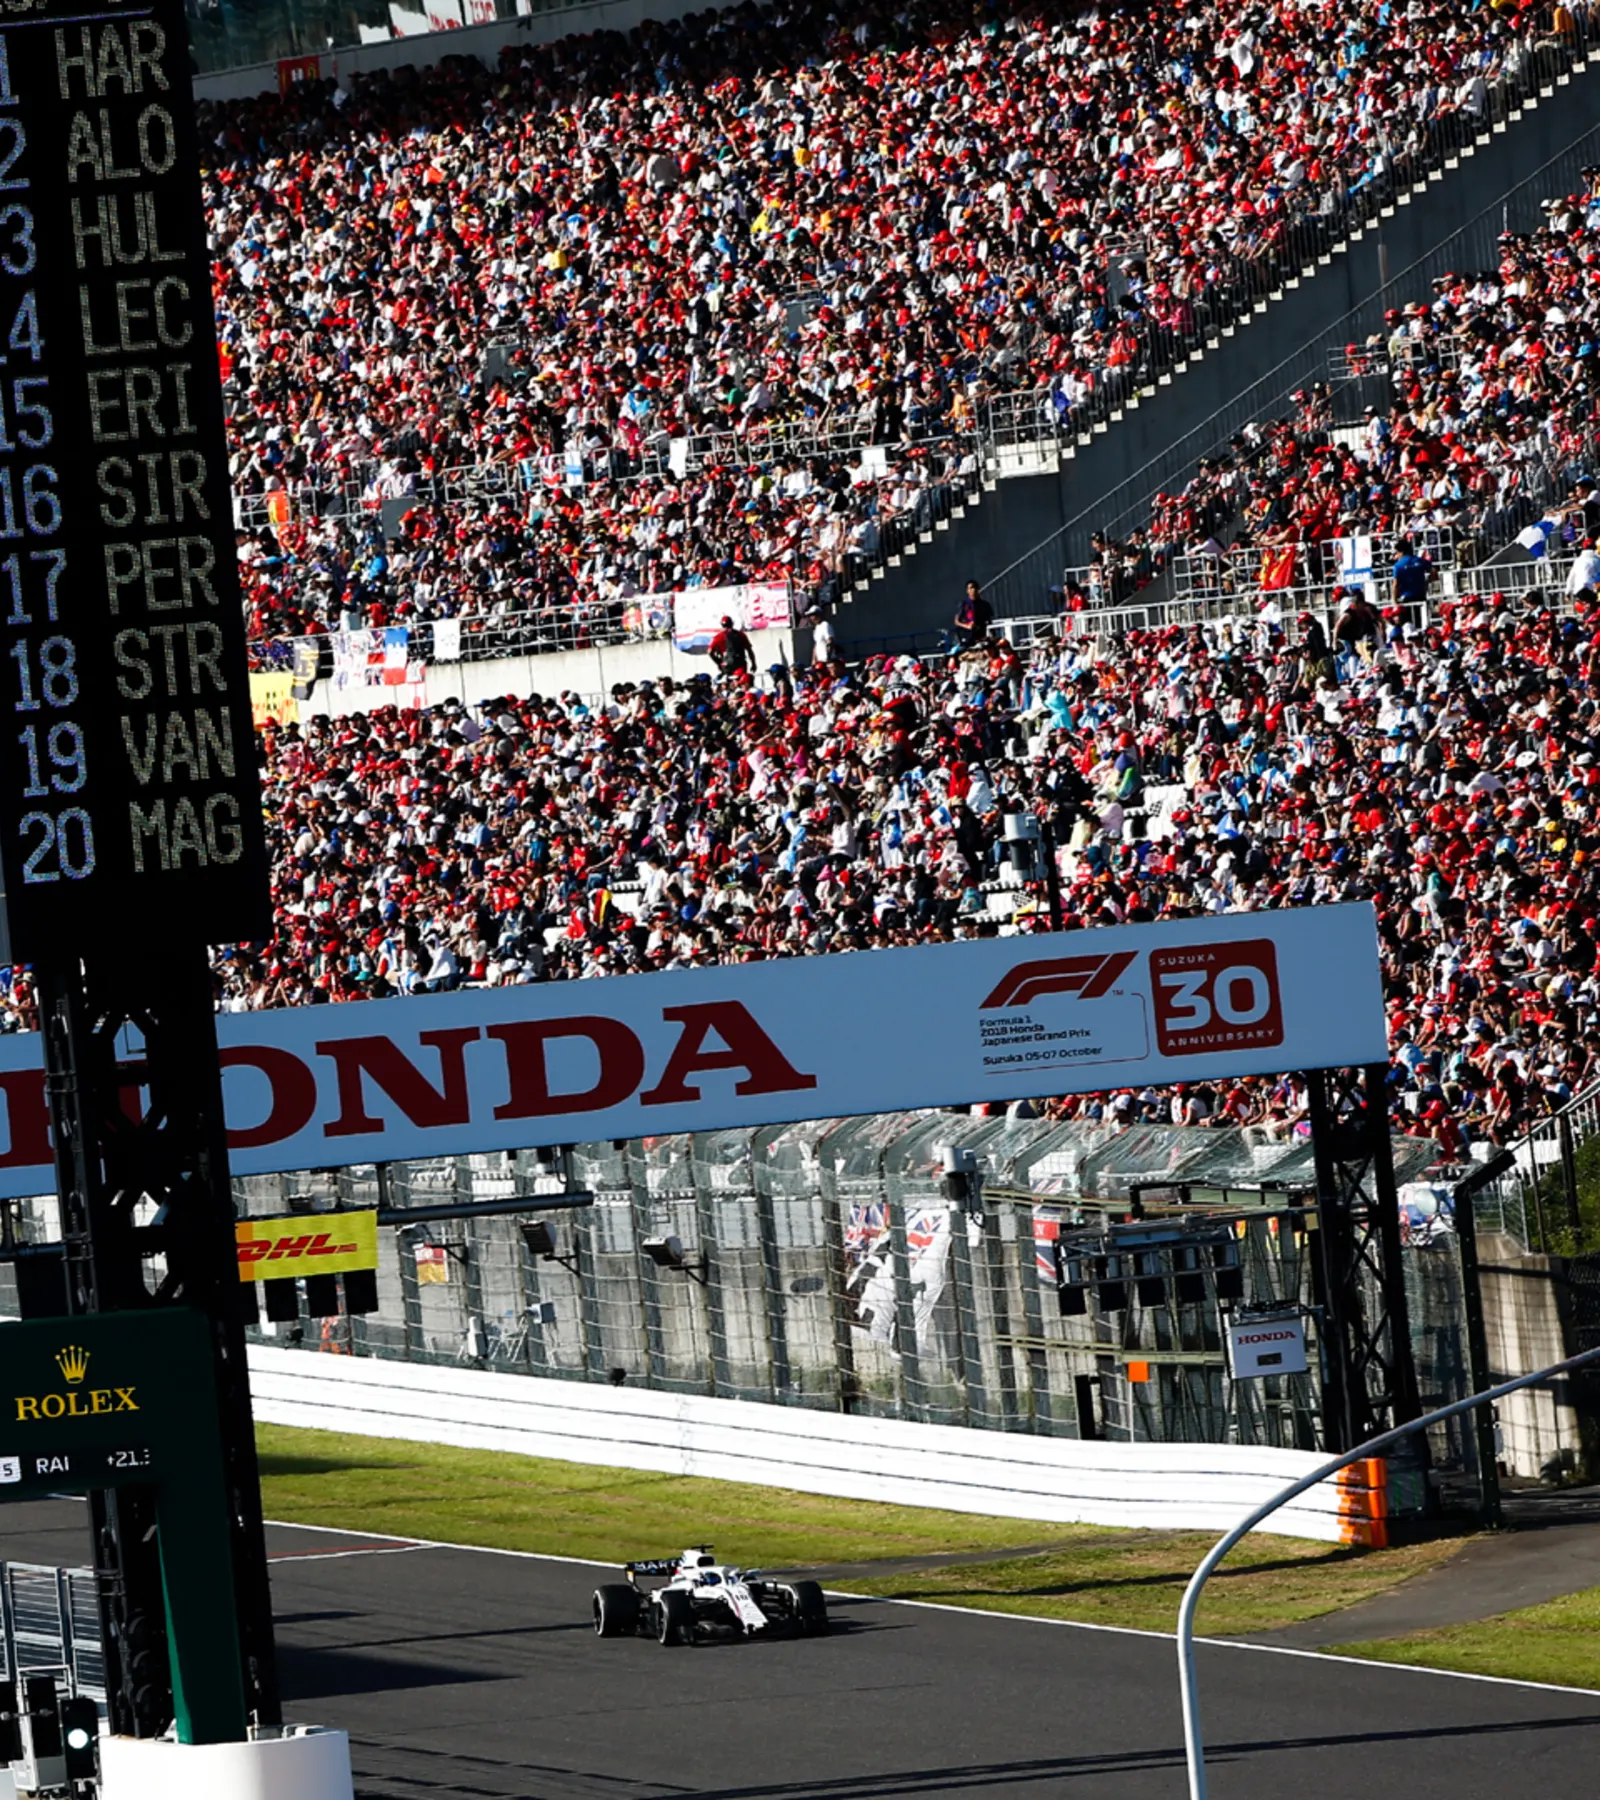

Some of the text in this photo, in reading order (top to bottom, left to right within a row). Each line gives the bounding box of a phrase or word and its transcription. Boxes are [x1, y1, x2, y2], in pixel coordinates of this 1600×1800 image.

[54, 19, 170, 99] HAR
[67, 103, 177, 183] ALO
[71, 191, 187, 269] HUL
[79, 275, 194, 356] LEC
[87, 362, 198, 442] ERI
[97, 450, 211, 527] SIR
[2, 534, 220, 625] 17 PER
[10, 635, 79, 711] 18
[113, 621, 228, 699] STR
[18, 706, 236, 798] 19 VAN
[18, 793, 244, 884] 20 MAG
[1158, 953, 1216, 967] SUZUKA
[980, 1014, 1032, 1028] Formula 1
[980, 1023, 1045, 1038] 2018 Honda
[1159, 965, 1271, 1031] 30
[981, 1028, 1092, 1047] Japanese Grand Prix
[983, 1046, 1103, 1066] Suzuka 05-07 October
[1167, 1028, 1276, 1048] ANNIVERSARY
[237, 1233, 338, 1262] DHL
[1237, 1330, 1297, 1346] HONDA
[15, 1387, 140, 1421] ROLEX
[2, 1463, 13, 1477] 5
[35, 1456, 70, 1474] RAI
